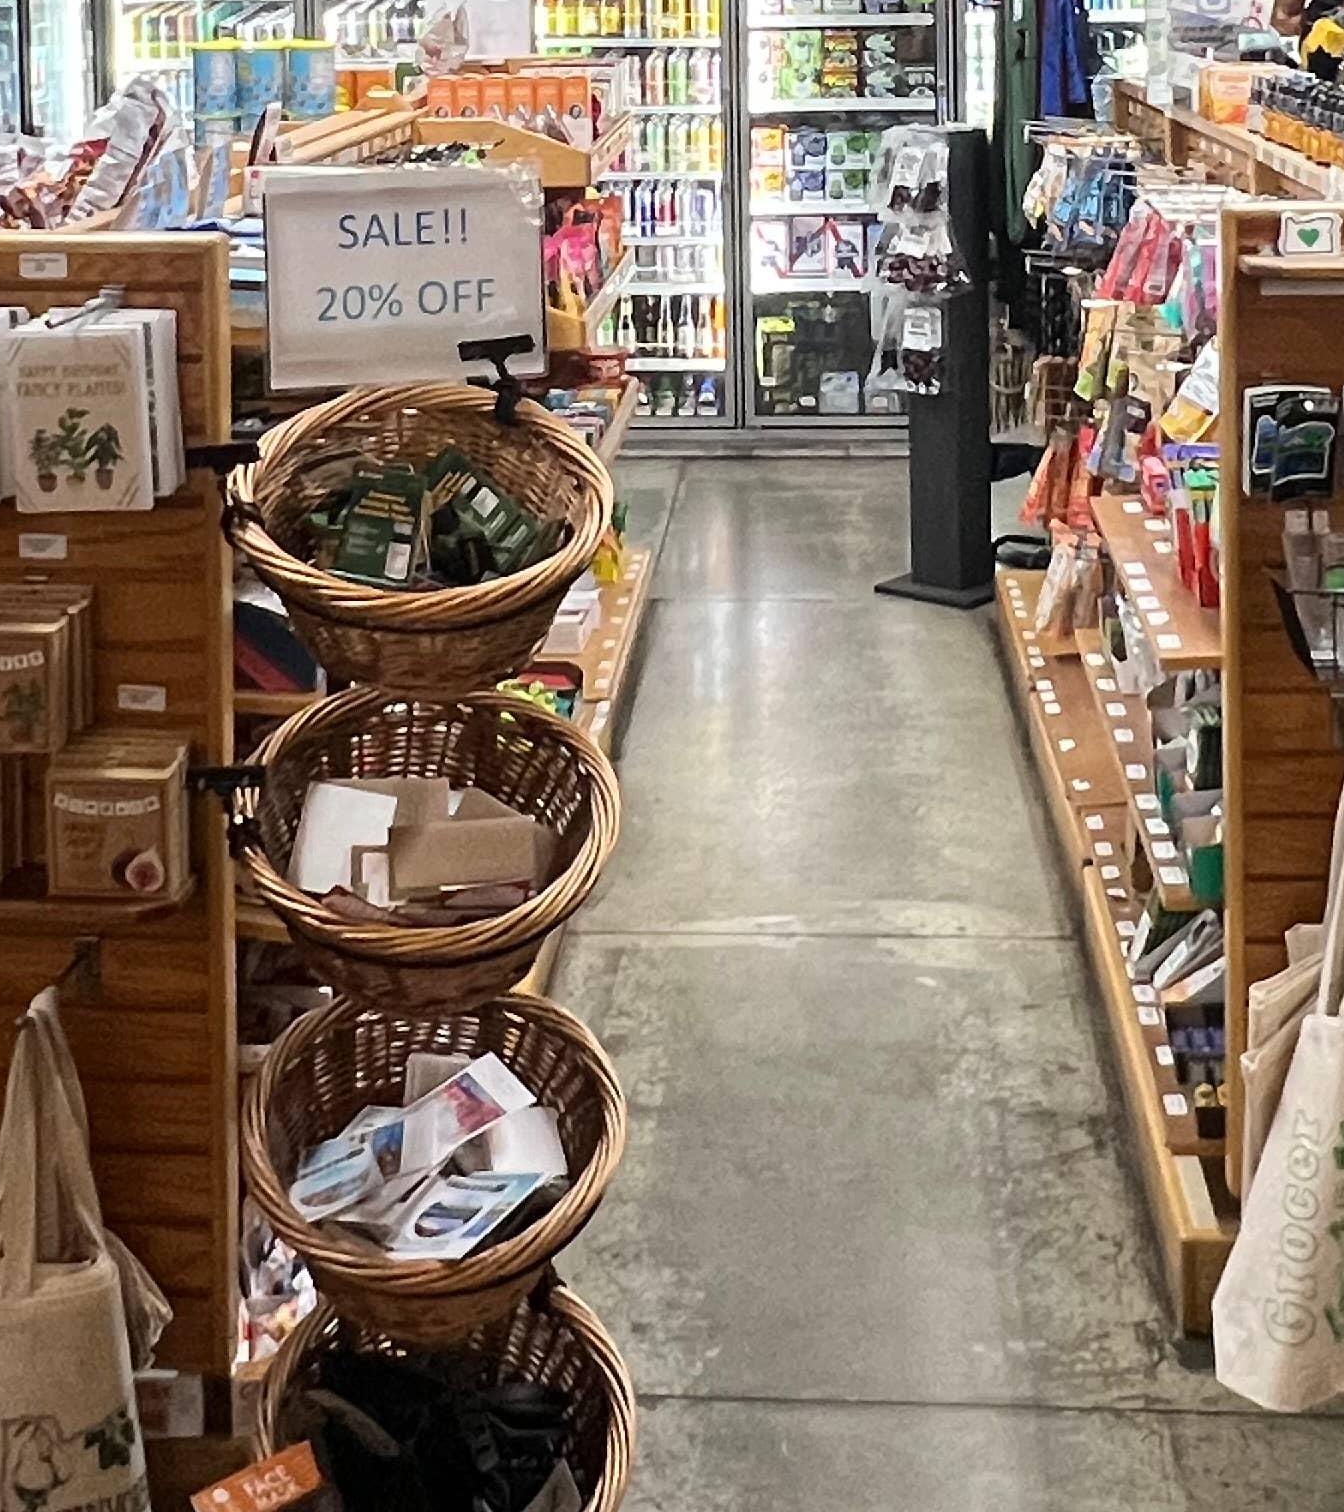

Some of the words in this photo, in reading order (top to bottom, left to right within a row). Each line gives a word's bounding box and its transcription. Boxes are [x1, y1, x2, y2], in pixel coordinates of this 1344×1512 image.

[338, 208, 468, 250] SALE!!
[317, 282, 404, 322] 20%
[418, 278, 496, 316] OFF
